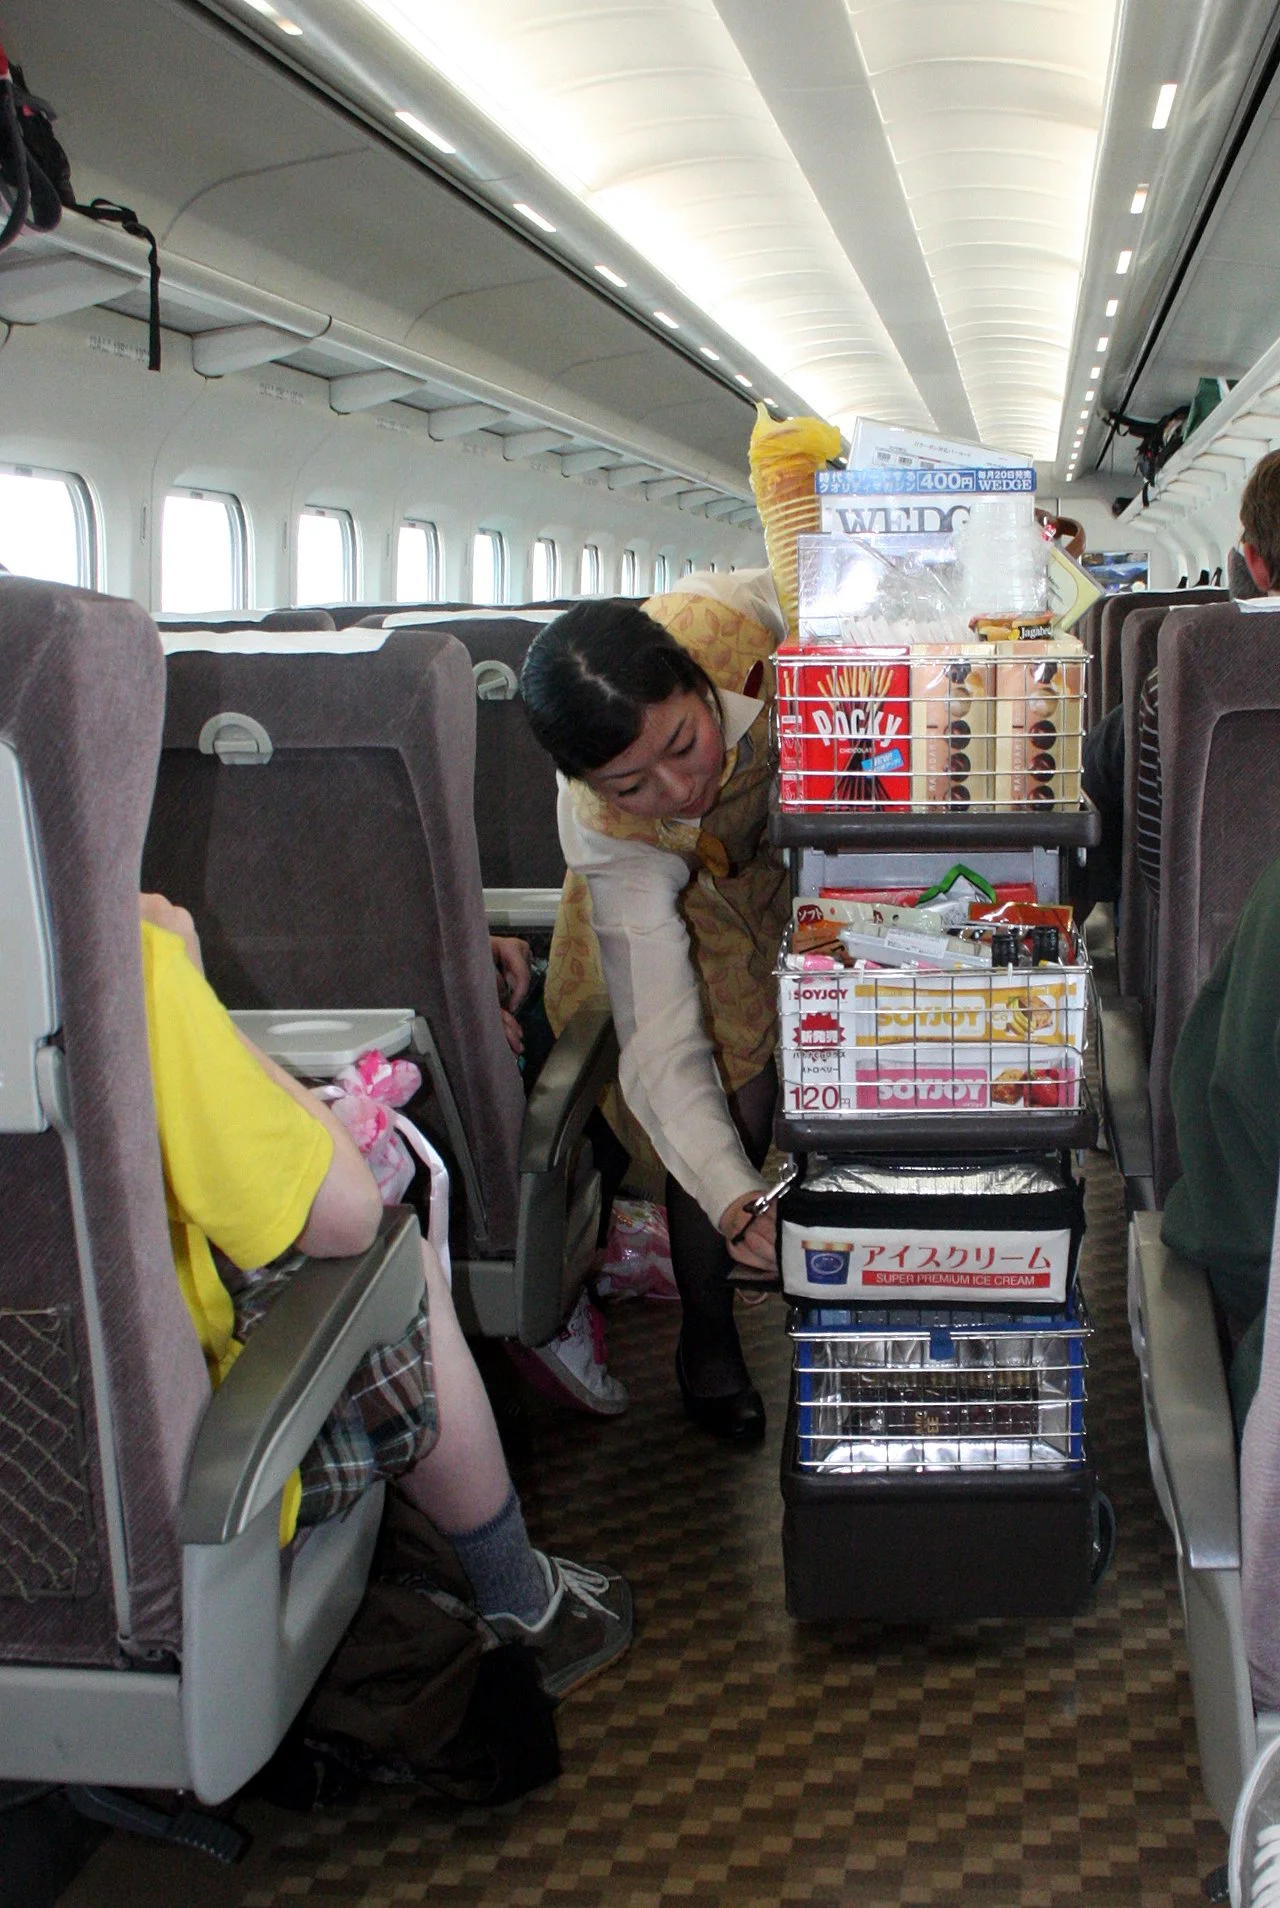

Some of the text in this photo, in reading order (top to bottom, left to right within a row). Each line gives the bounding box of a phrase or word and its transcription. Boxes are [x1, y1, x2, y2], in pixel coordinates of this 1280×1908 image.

[921, 472, 973, 490] 400円
[977, 470, 1032, 479] 毎月20日発売
[979, 479, 1032, 491] WEDGE
[836, 505, 971, 533] WEDG
[798, 908, 822, 921] ソフト
[793, 989, 849, 1000] SOYJOY
[877, 1006, 982, 1027] SOYJOY
[878, 1079, 986, 1100] SOYJOY
[861, 1244, 1051, 1269] アイスクリーム
[876, 1273, 1035, 1286] SUPER PREMIUM ICE CREAM
